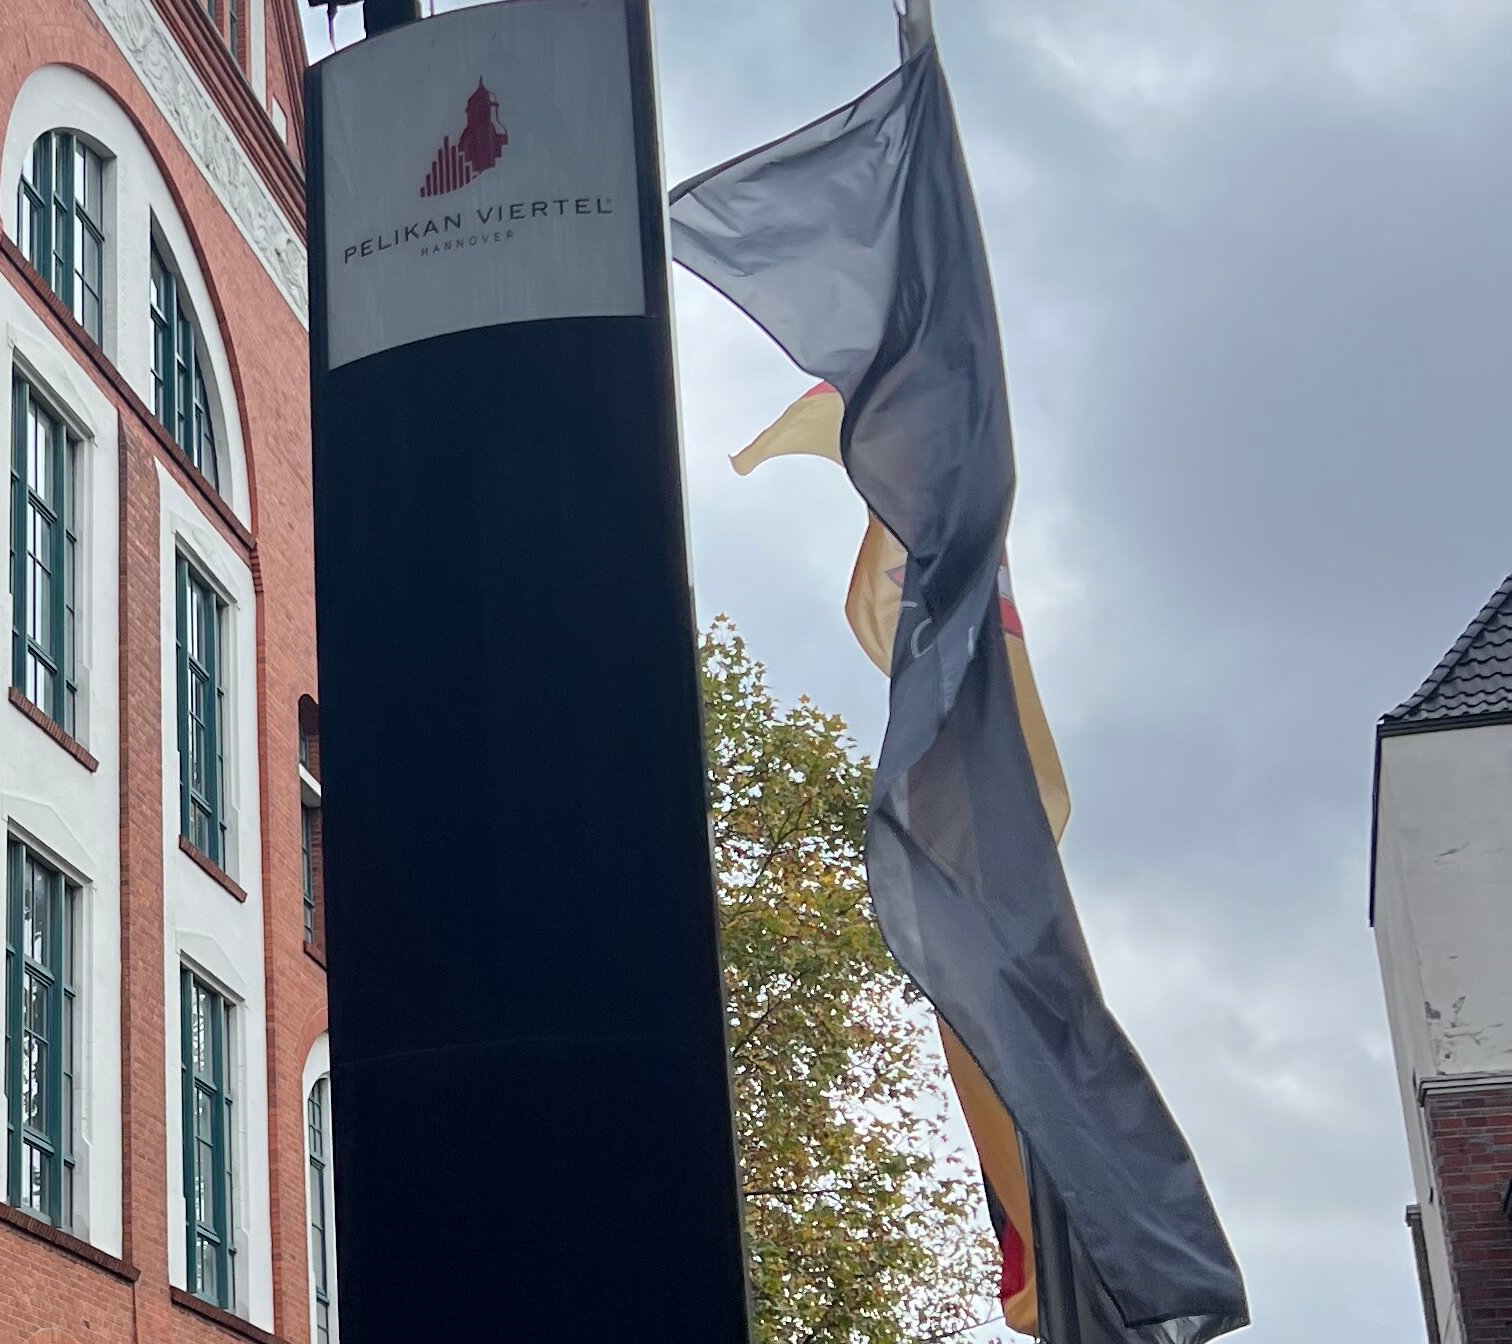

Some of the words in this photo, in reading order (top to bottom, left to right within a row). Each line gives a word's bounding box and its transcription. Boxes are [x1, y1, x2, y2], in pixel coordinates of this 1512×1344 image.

[344, 213, 462, 264] PELIKAN
[475, 198, 613, 224] VIERTEL
[420, 230, 514, 256] HANNOVER
